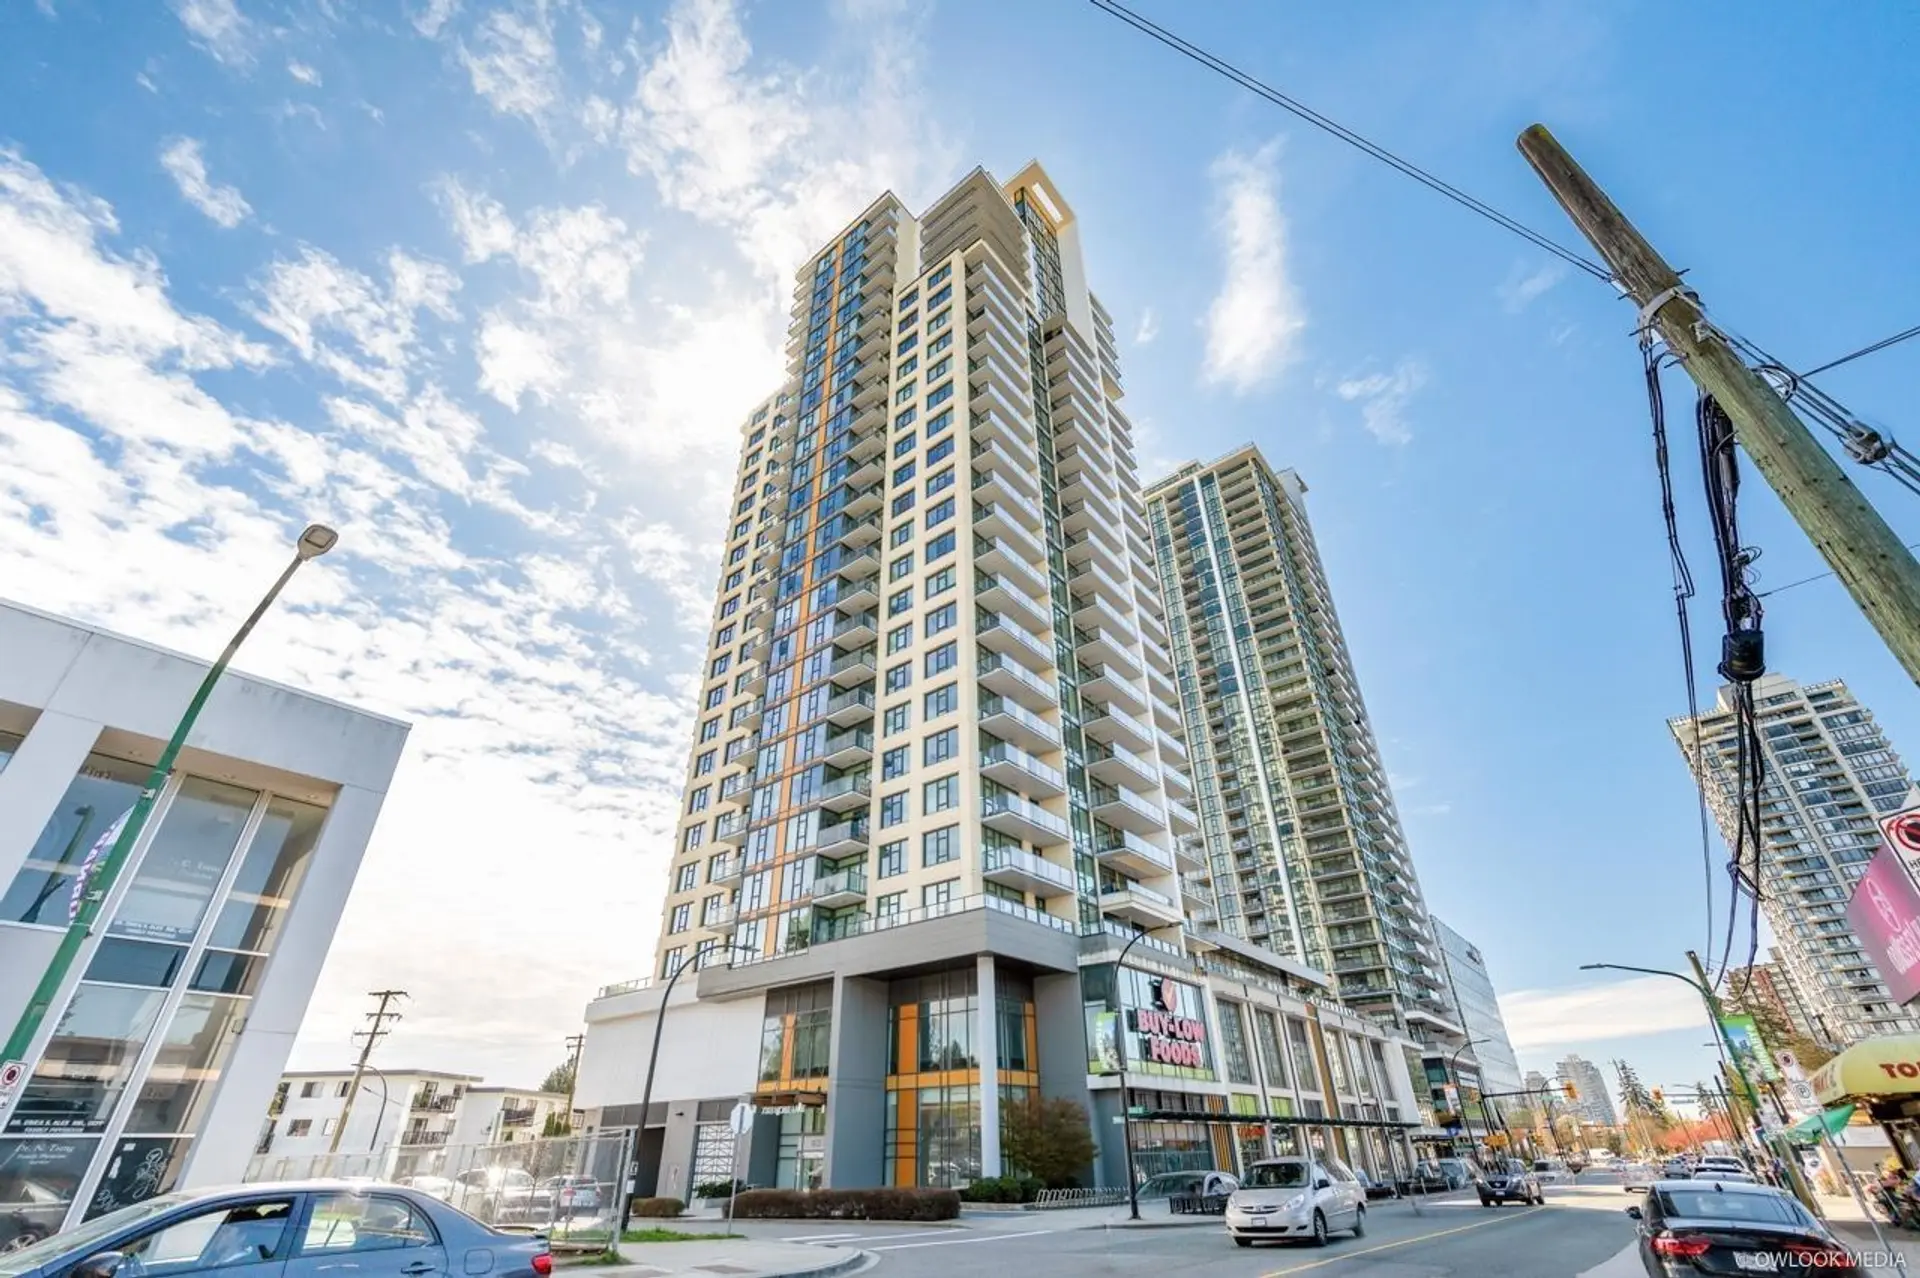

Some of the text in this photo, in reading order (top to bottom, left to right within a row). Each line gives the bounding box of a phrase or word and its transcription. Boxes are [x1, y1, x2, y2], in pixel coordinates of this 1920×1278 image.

[1137, 1008, 1206, 1042] BUY-LOW
[1149, 1035, 1201, 1068] FOODS
[1878, 1061, 1920, 1079] TO
